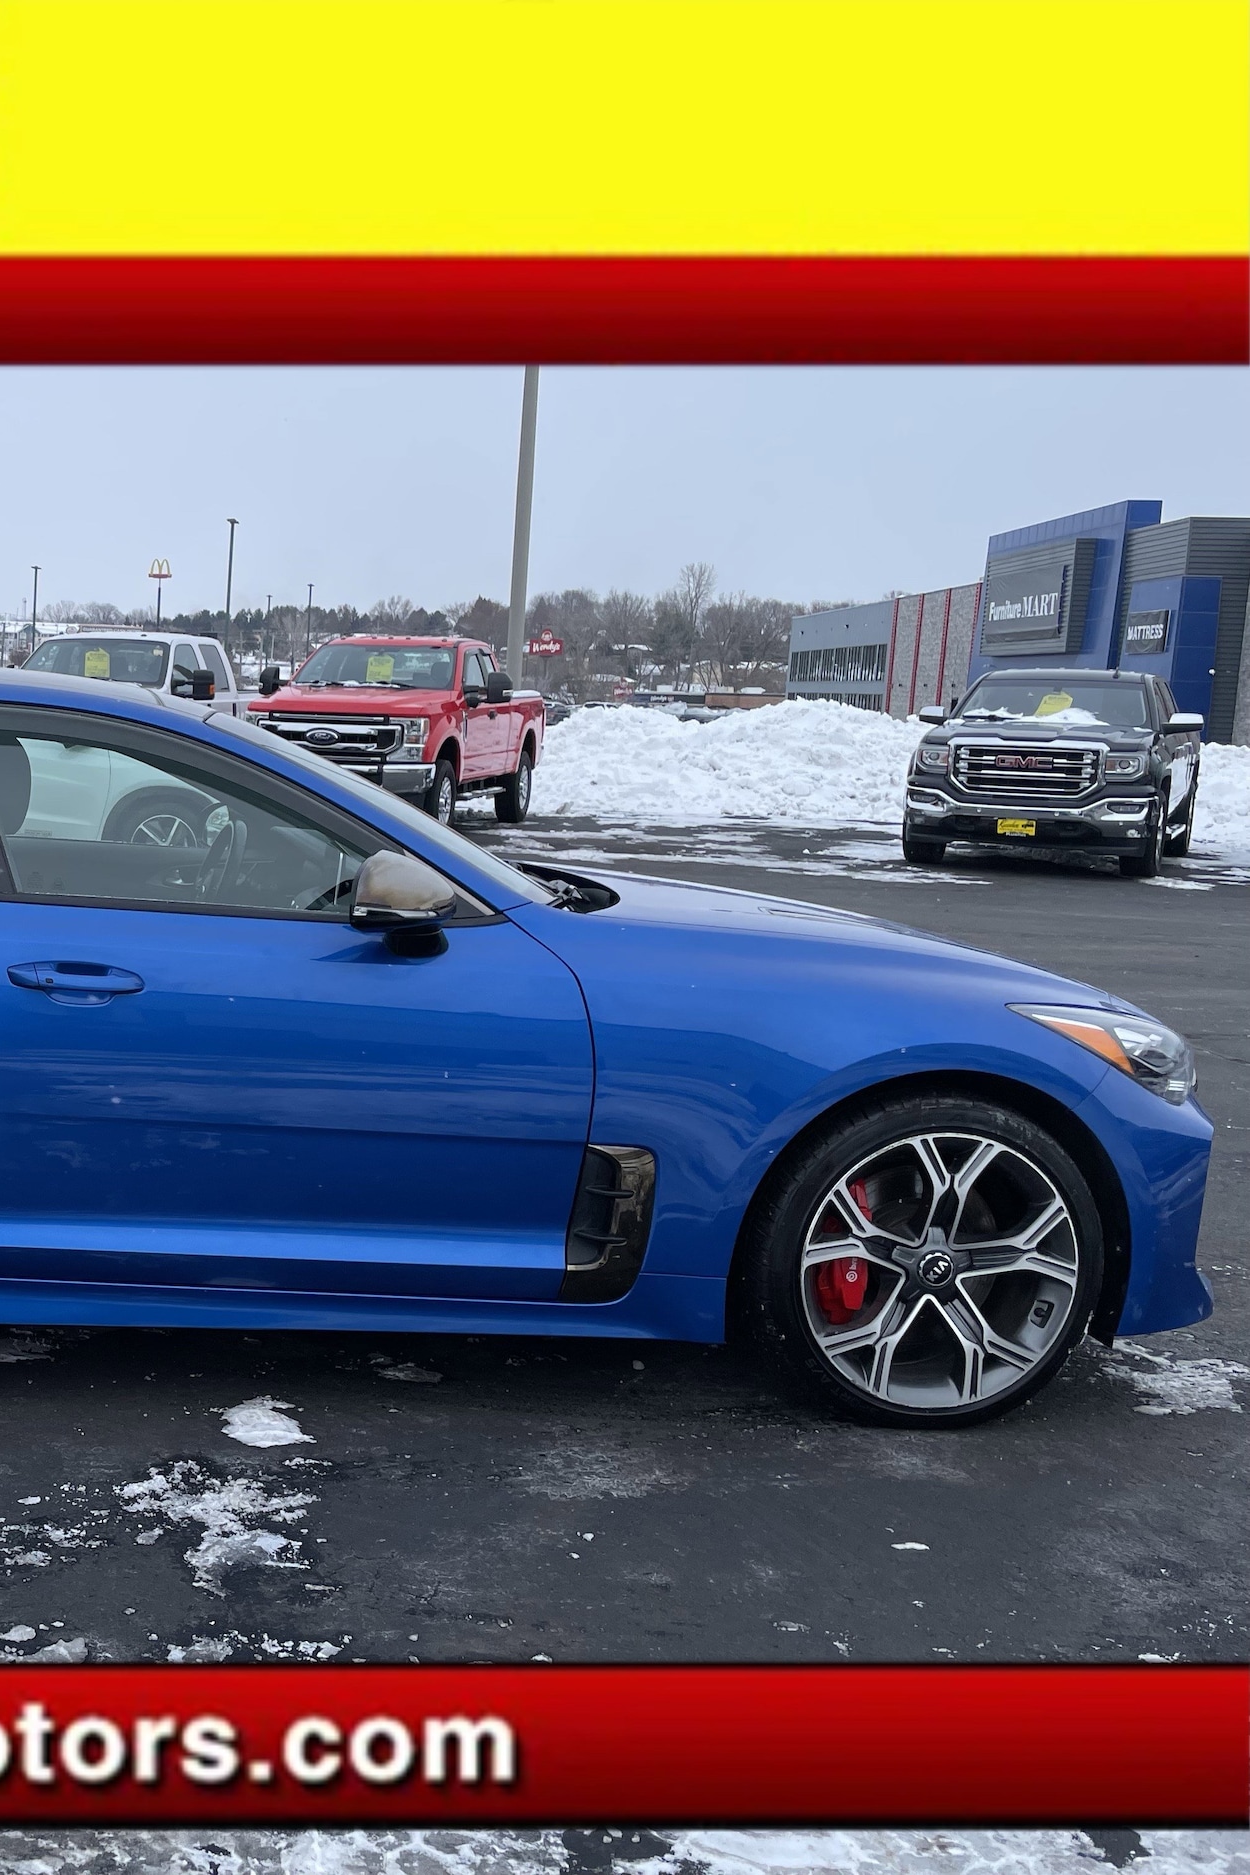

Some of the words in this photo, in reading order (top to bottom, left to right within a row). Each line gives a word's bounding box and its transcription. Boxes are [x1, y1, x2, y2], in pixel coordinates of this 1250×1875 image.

[1127, 624, 1164, 641] MATTRESS
[533, 641, 560, 653] Wendy's
[996, 755, 1053, 769] GMC
[926, 1260, 949, 1281] KIA
